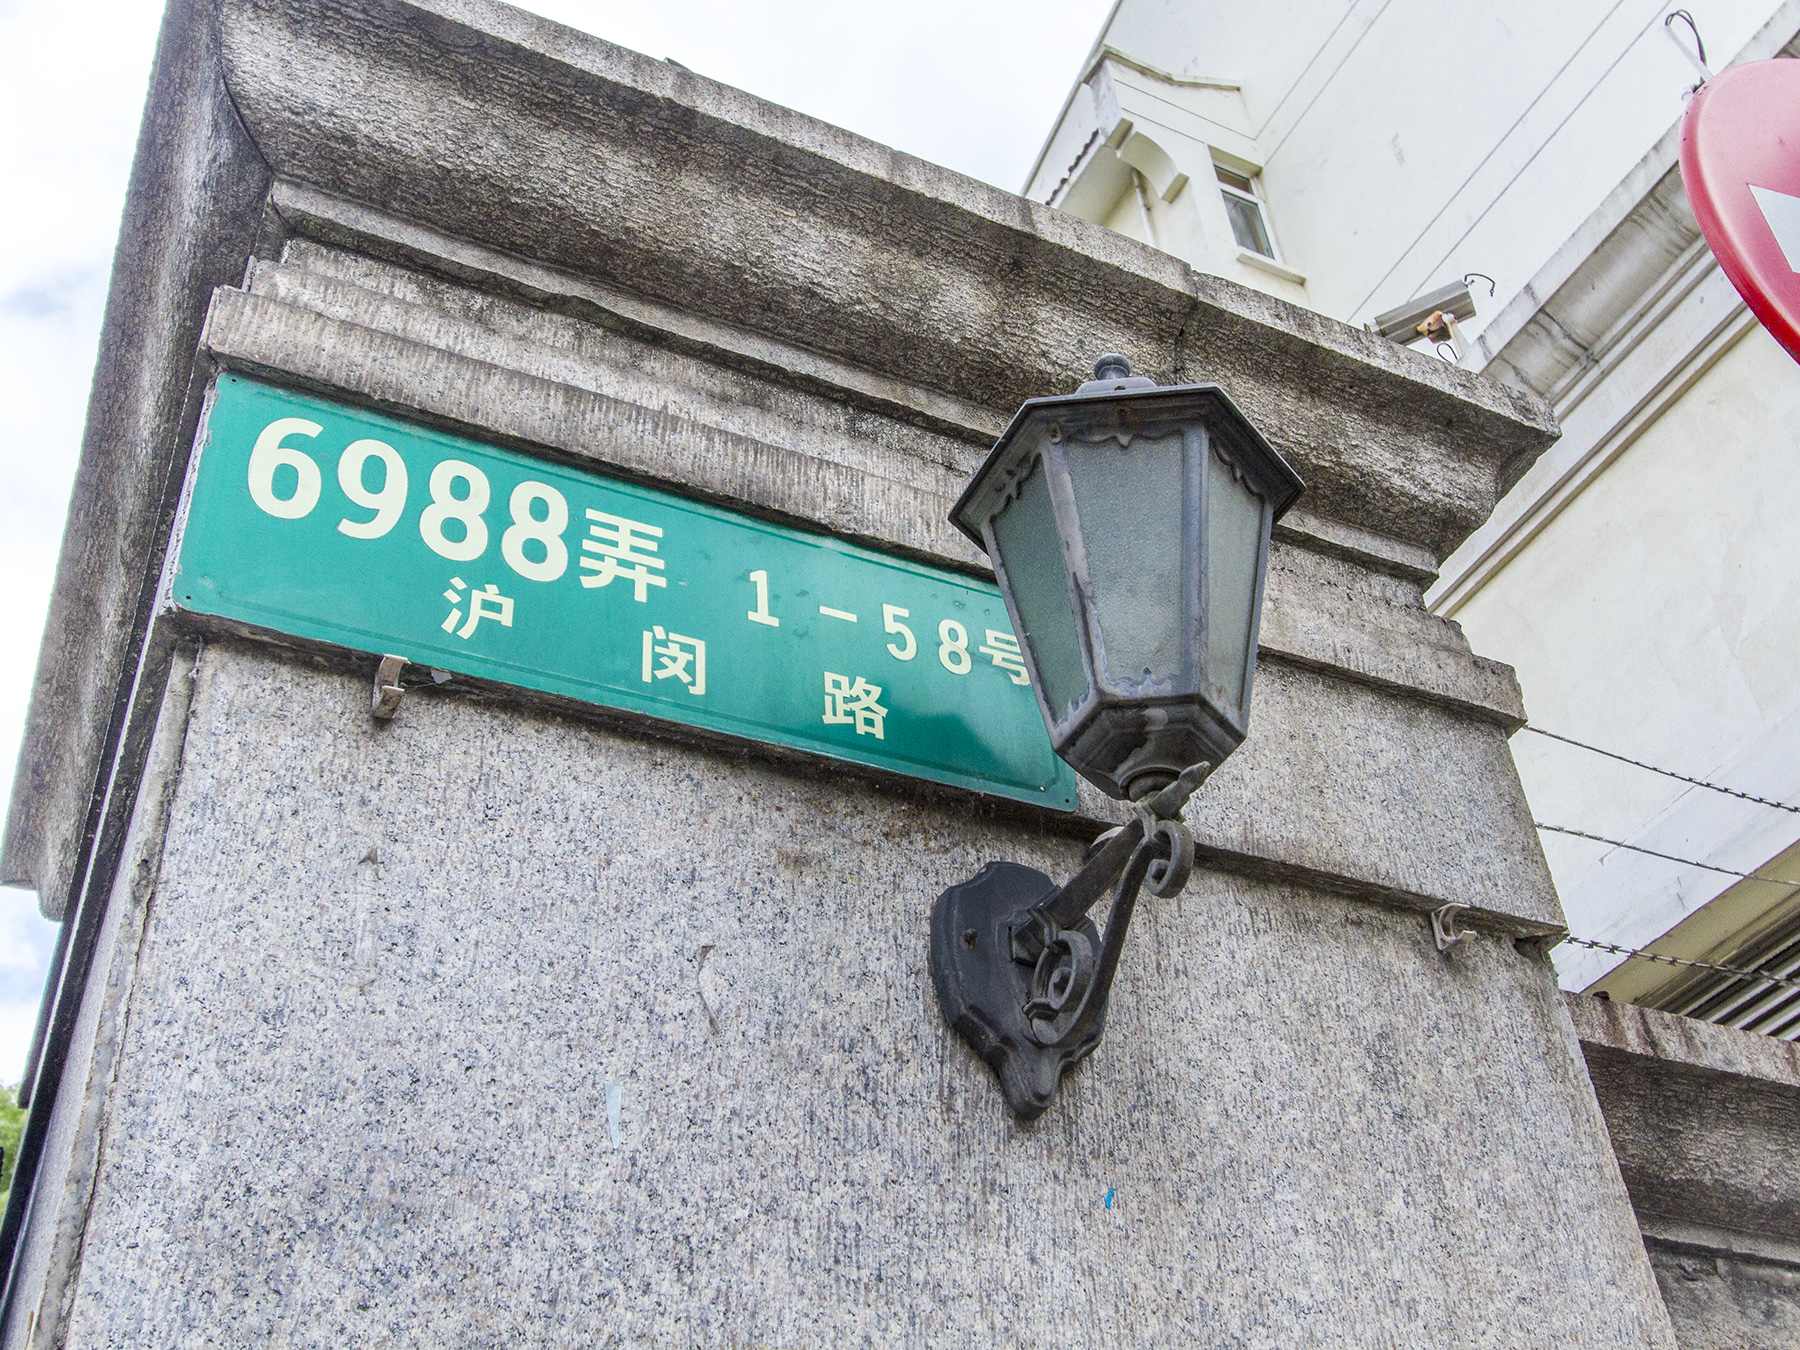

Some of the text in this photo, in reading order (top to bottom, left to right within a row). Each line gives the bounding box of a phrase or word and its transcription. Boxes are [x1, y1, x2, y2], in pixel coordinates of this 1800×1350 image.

[247, 417, 667, 602] 6988弄
[441, 576, 889, 740] 沪闵路
